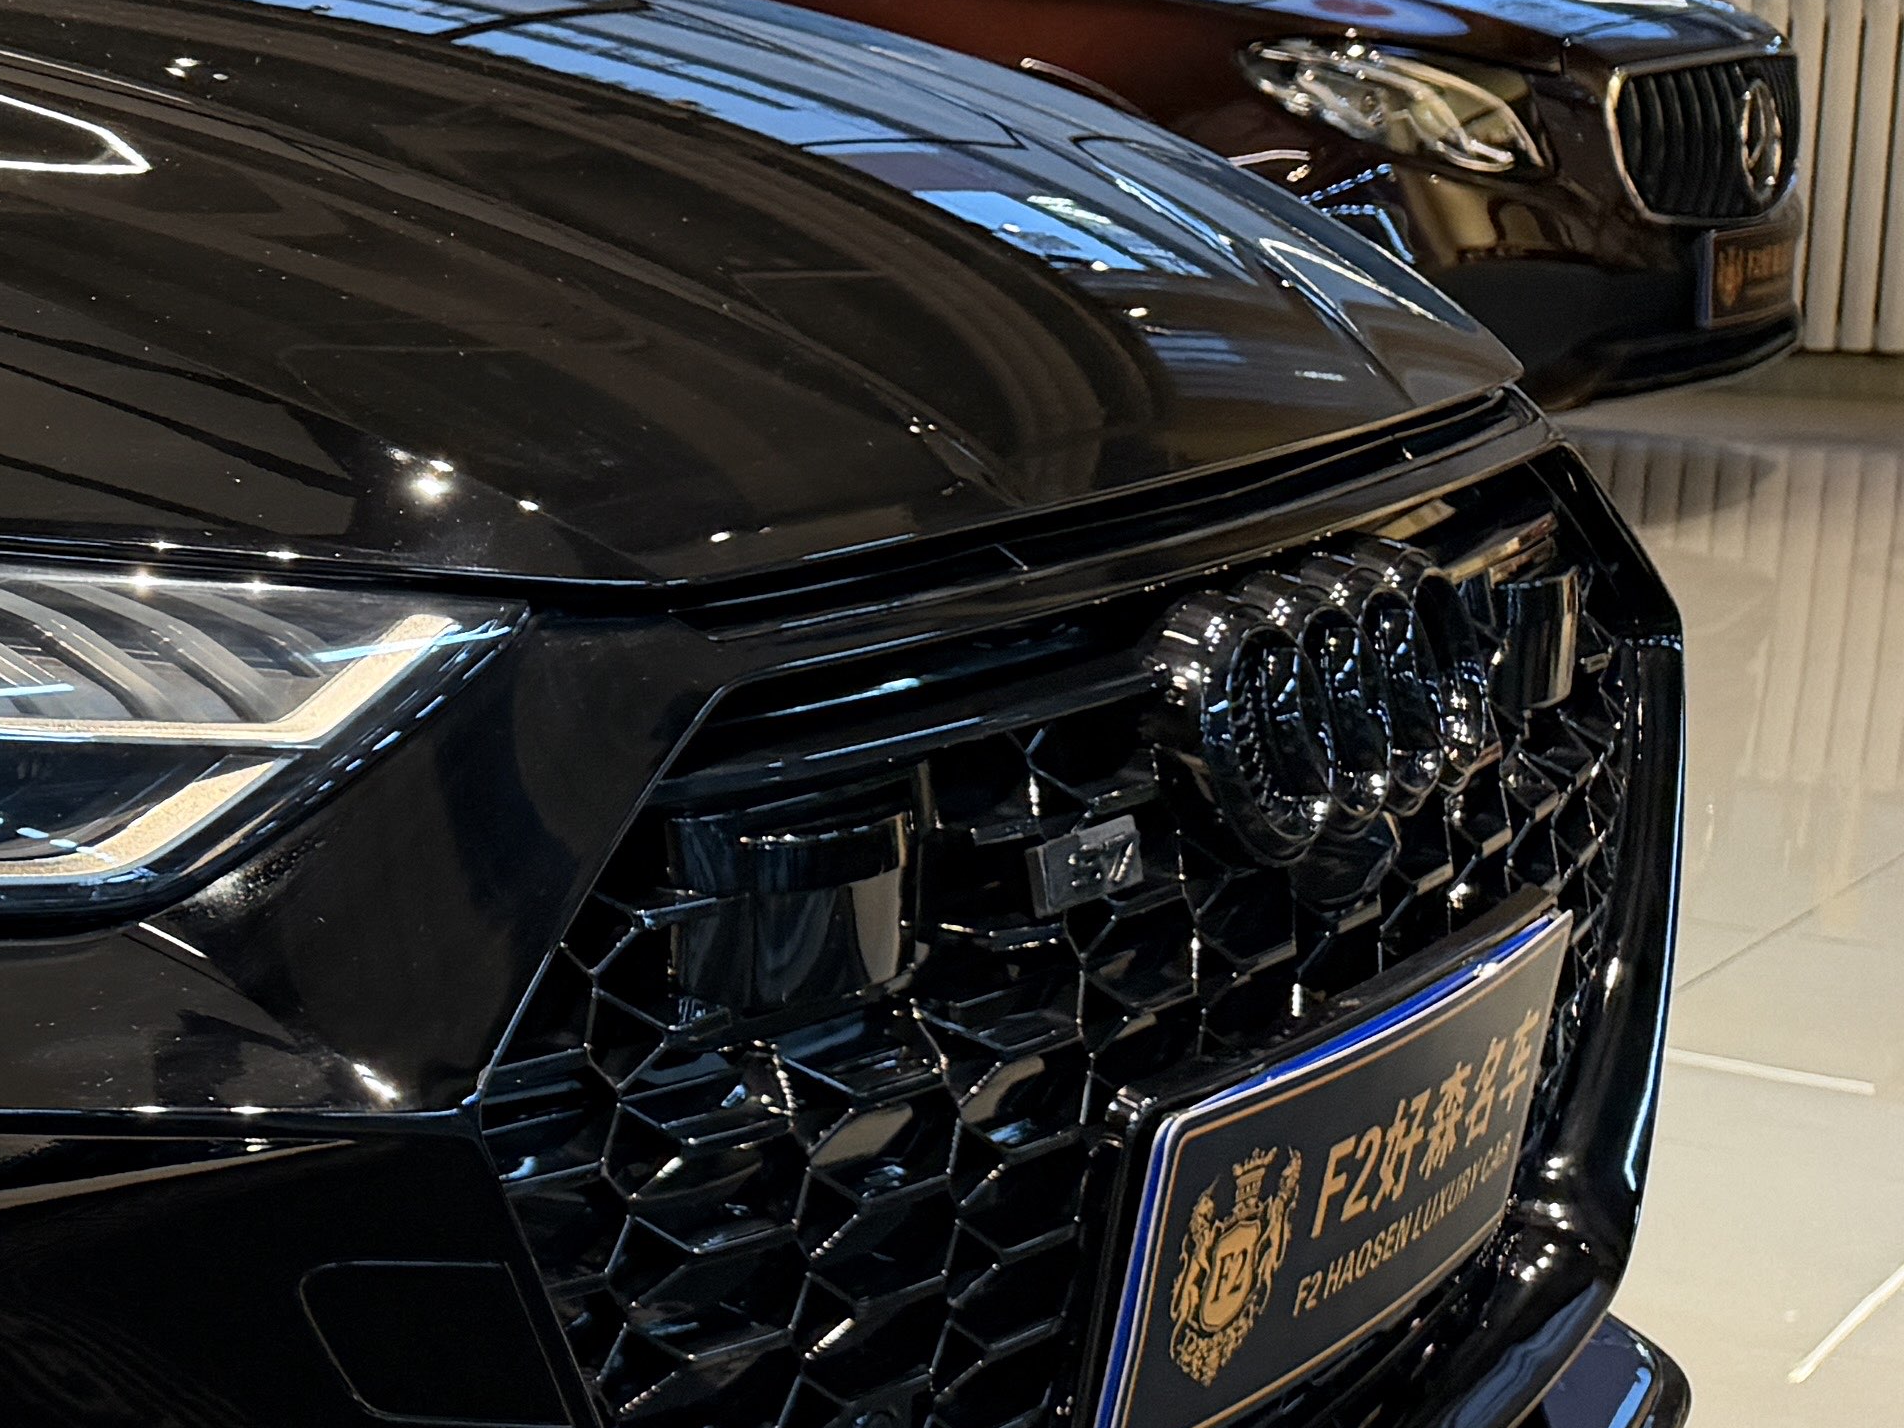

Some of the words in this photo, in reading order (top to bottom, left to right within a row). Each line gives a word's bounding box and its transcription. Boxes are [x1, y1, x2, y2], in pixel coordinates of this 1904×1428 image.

[1310, 1009, 1540, 1239] F2好森名车
[1210, 1248, 1248, 1303] F2
[1293, 1270, 1323, 1317] F2
[1323, 1212, 1414, 1299] HAOSEN
[1411, 1156, 1483, 1241] LUXURY
